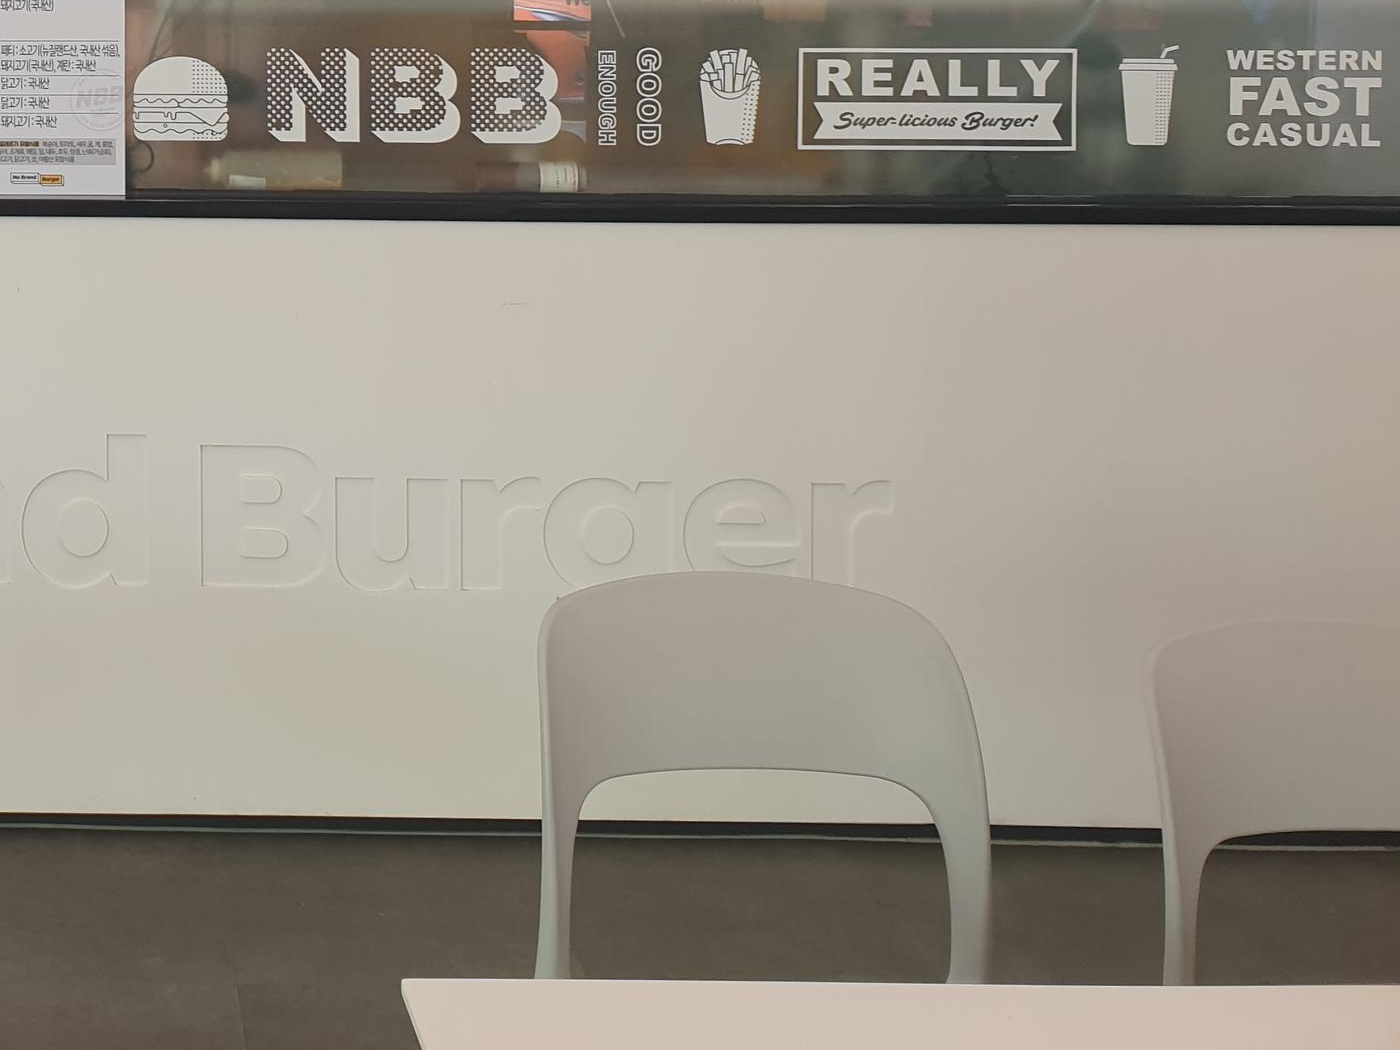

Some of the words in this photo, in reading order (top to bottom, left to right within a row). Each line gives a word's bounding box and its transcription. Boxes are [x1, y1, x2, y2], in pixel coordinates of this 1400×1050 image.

[816, 58, 1061, 97] REALLY
[1226, 50, 1383, 72] WESTERN
[266, 47, 562, 144] NBB
[598, 50, 617, 146] ENOUGH
[636, 47, 663, 147] GOOD
[1229, 76, 1382, 117] FAST
[833, 111, 957, 131] Super-licious
[961, 111, 1038, 131] Burger!
[1226, 122, 1382, 148] CASUAL
[199, 442, 895, 592] Burger
